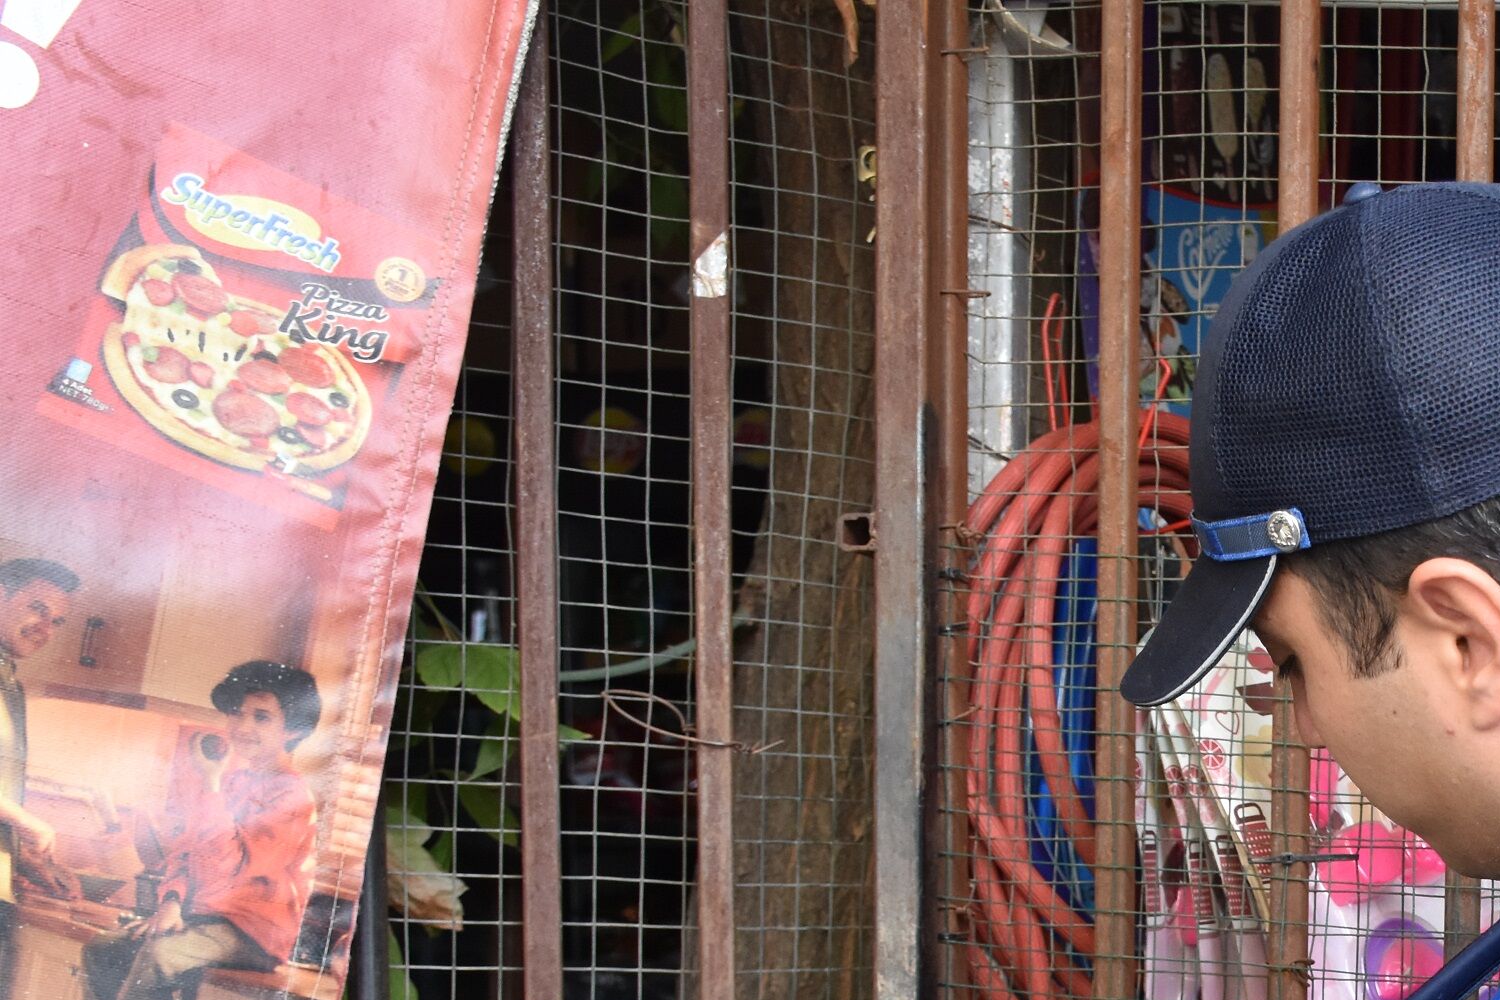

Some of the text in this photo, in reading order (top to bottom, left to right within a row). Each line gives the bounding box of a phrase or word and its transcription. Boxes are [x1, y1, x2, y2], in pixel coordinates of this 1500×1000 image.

[161, 172, 341, 272] SuperFresh
[278, 301, 390, 362] King
[302, 283, 389, 322] Pizza
